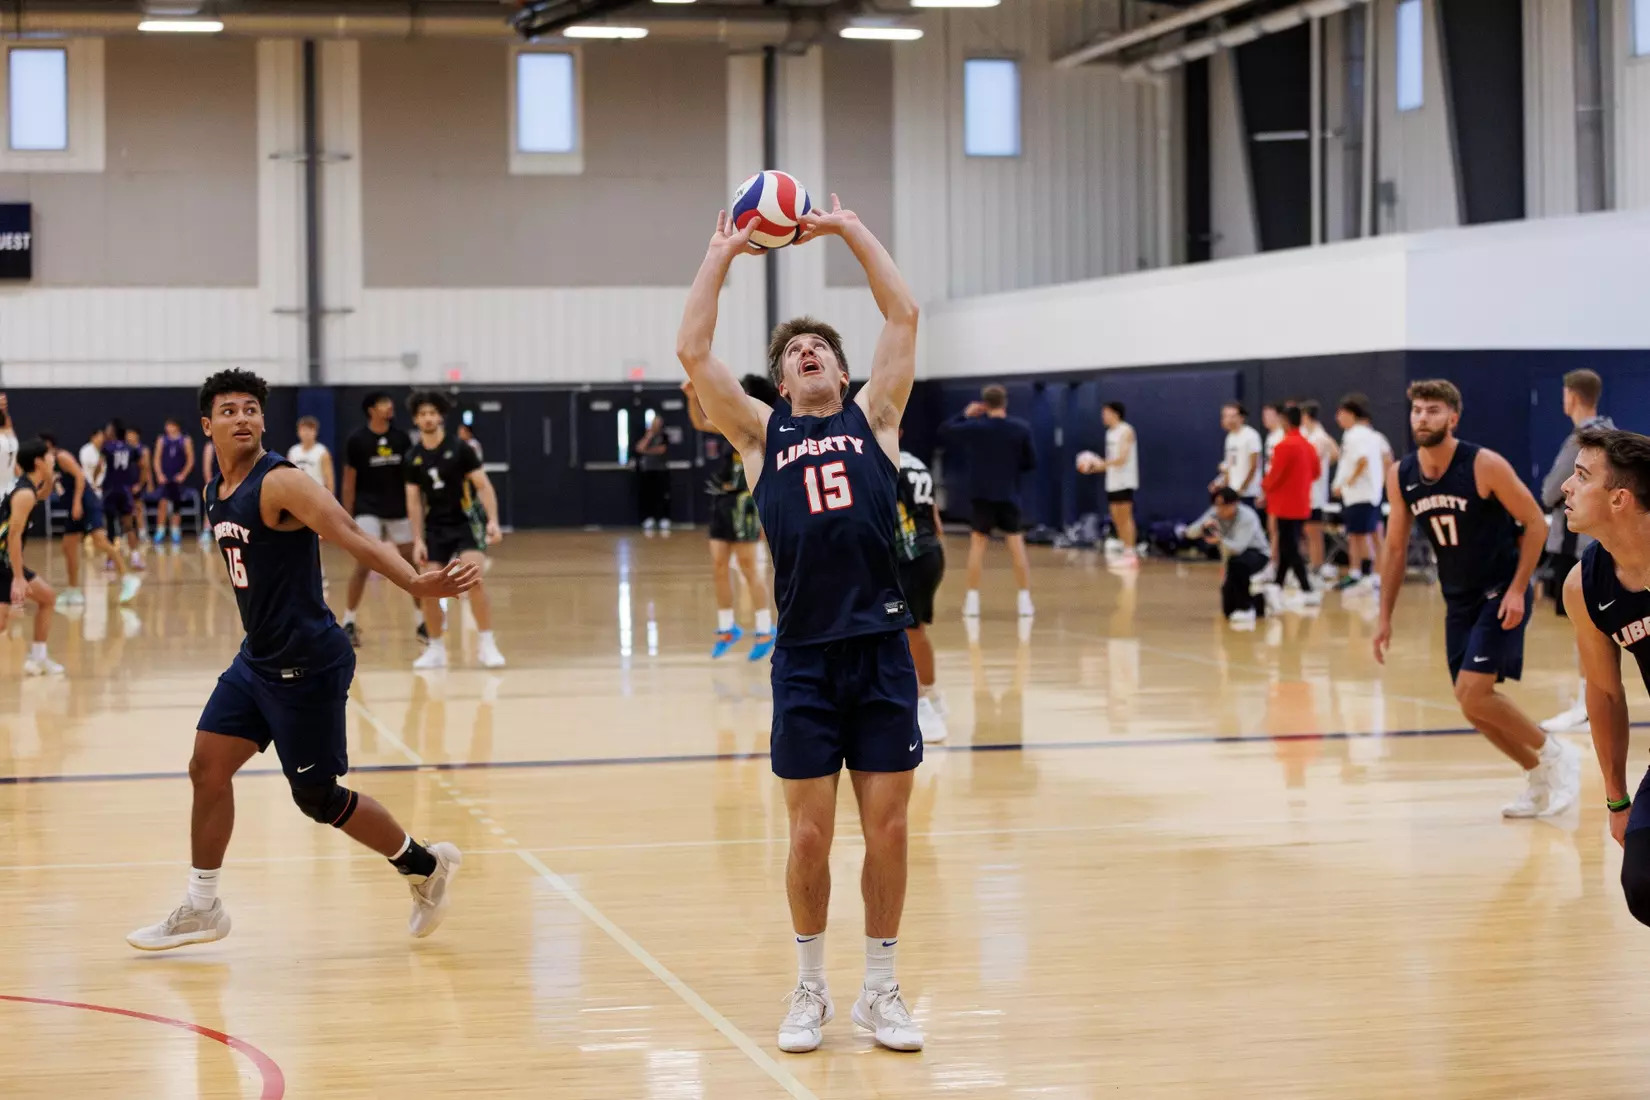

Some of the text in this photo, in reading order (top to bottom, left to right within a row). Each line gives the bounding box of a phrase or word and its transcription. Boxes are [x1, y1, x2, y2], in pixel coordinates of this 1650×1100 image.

[776, 434, 864, 472] LIBERTY
[803, 460, 854, 515] 15
[907, 470, 934, 505] 22
[1410, 494, 1468, 516] LIBERTY
[1429, 514, 1459, 546] 17
[223, 547, 249, 589] 16
